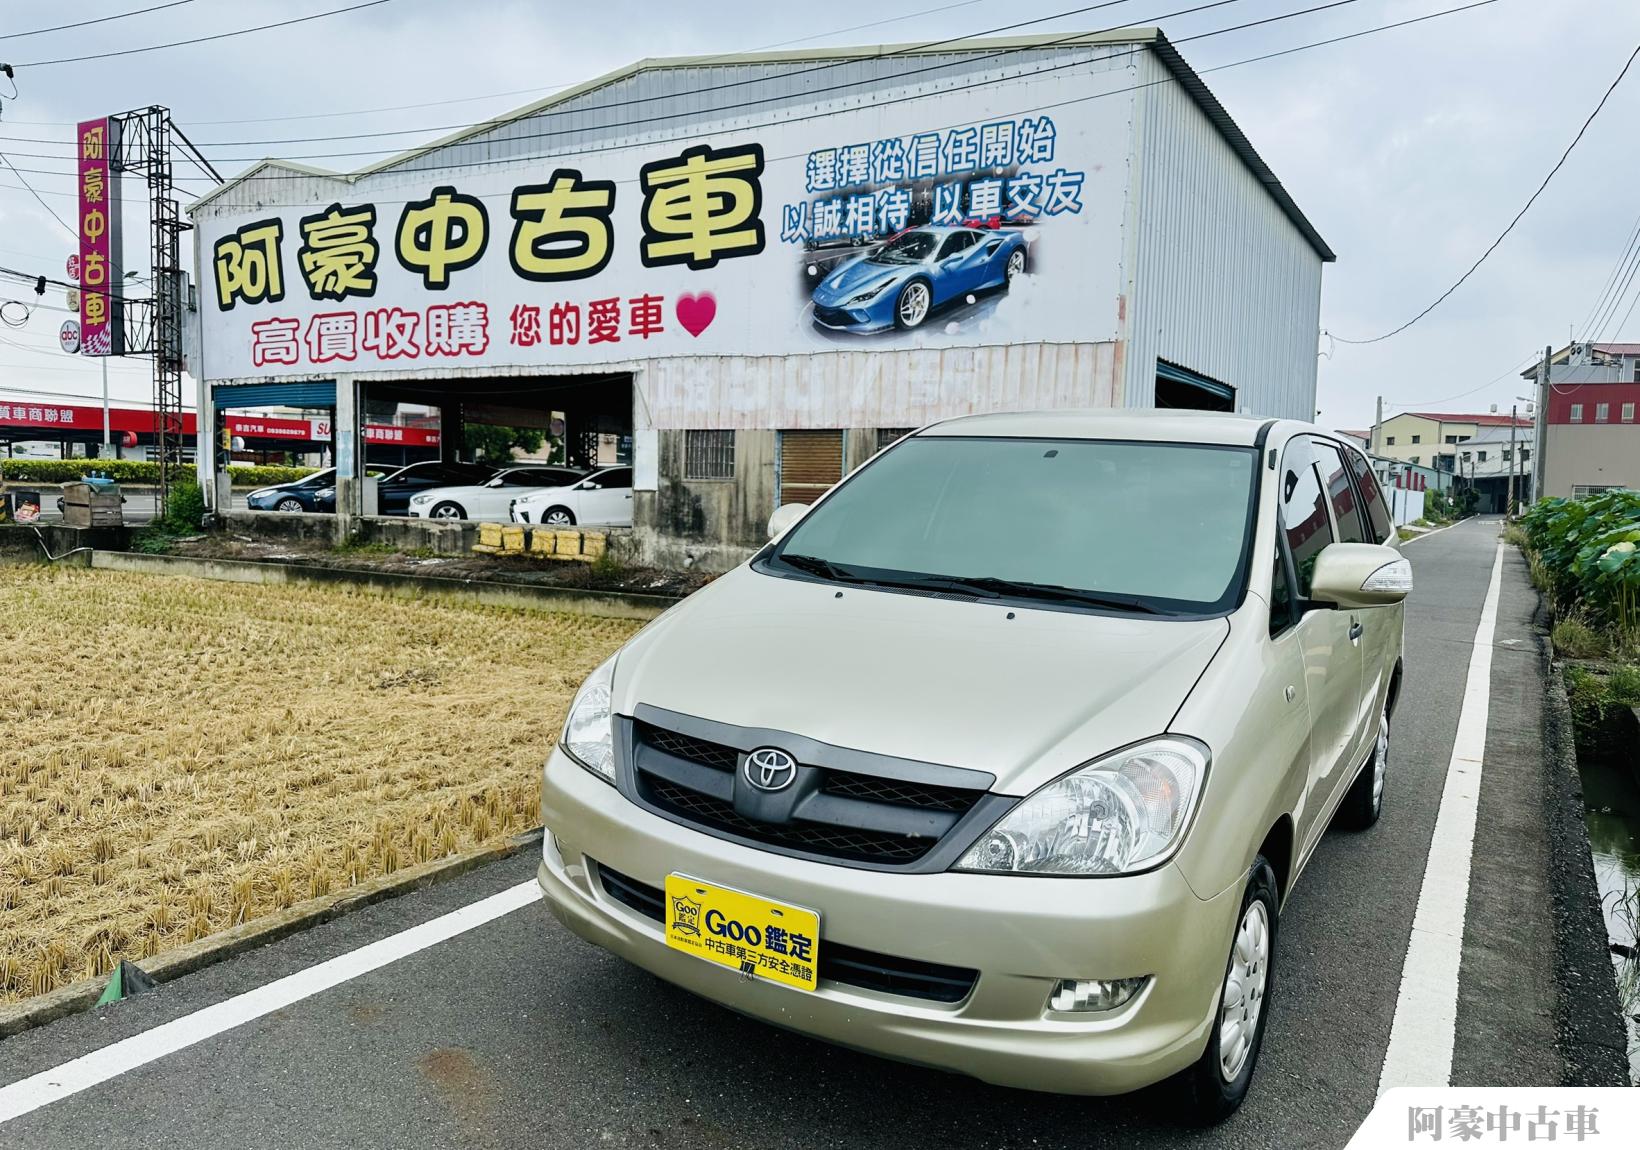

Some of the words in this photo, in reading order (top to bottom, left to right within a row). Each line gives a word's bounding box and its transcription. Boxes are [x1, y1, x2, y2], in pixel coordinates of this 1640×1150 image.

[806, 116, 1056, 192] 選擇從信任開始
[83, 127, 105, 326] 阿豪中古車
[213, 143, 765, 312] 阿豪中古車
[780, 188, 911, 243] 以誠相待
[930, 168, 1085, 225] 以車交友
[251, 302, 490, 366] 高價收購
[509, 294, 665, 347] 您的愛車
[675, 901, 698, 917] Goo
[705, 909, 762, 947] Goo
[764, 924, 812, 963] 鑑定
[704, 937, 813, 983] 中古車第三方安全憑證
